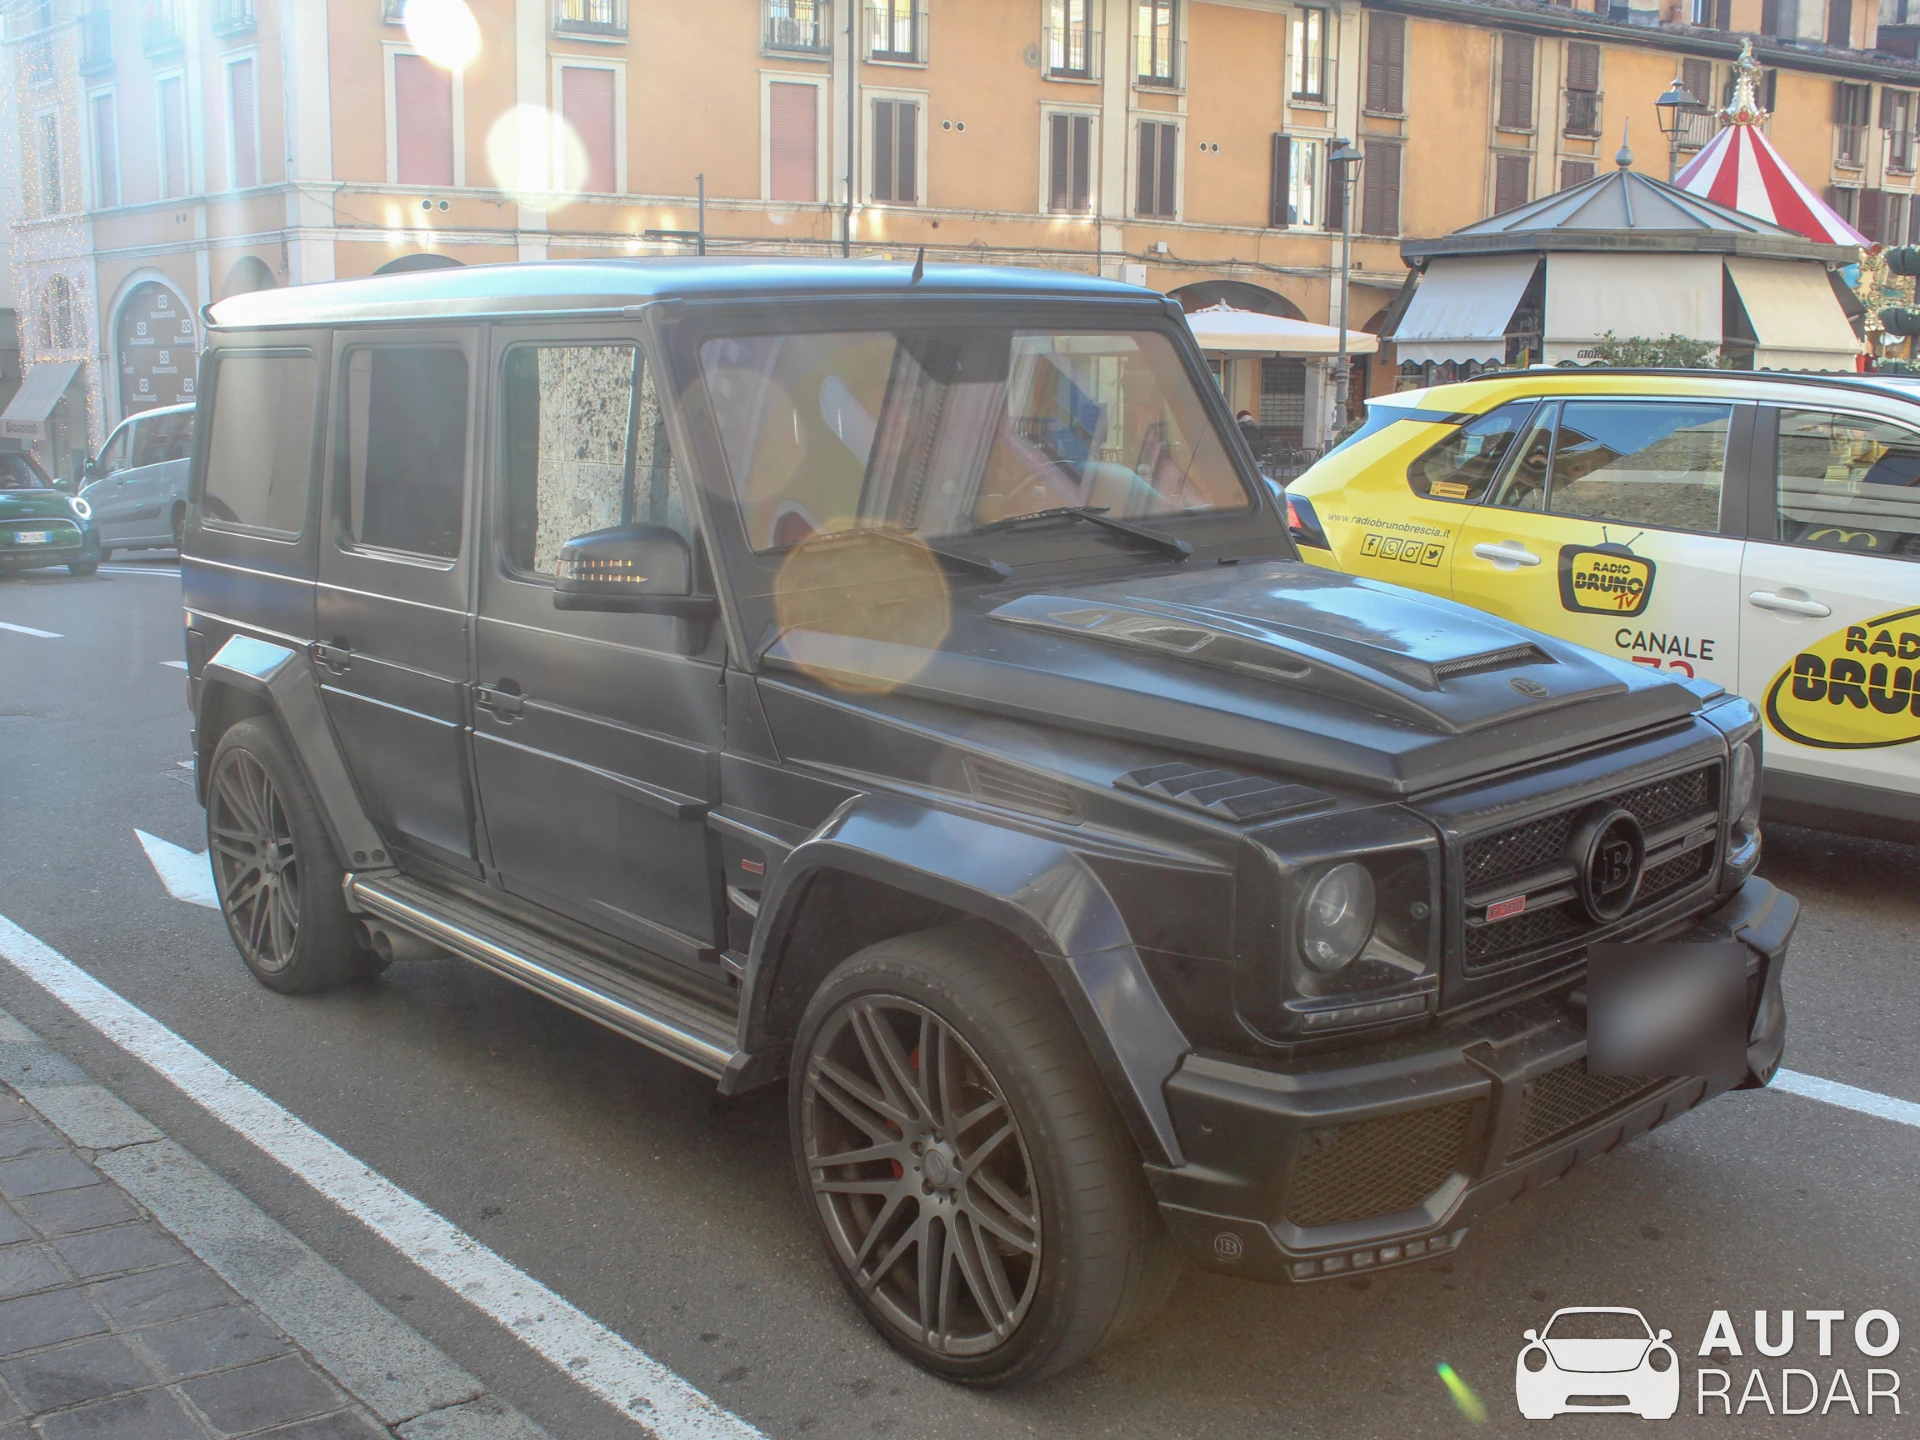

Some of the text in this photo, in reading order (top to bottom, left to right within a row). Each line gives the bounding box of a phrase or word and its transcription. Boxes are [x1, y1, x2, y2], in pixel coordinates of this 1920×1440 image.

[1577, 350, 1602, 359] GIOR
[1327, 513, 1451, 538] www.radiobrunobrescia.it
[1593, 562, 1631, 575] RADIO
[1574, 572, 1644, 595] BRUNO
[1613, 593, 1640, 609] TV
[1615, 628, 1715, 661] CANALE
